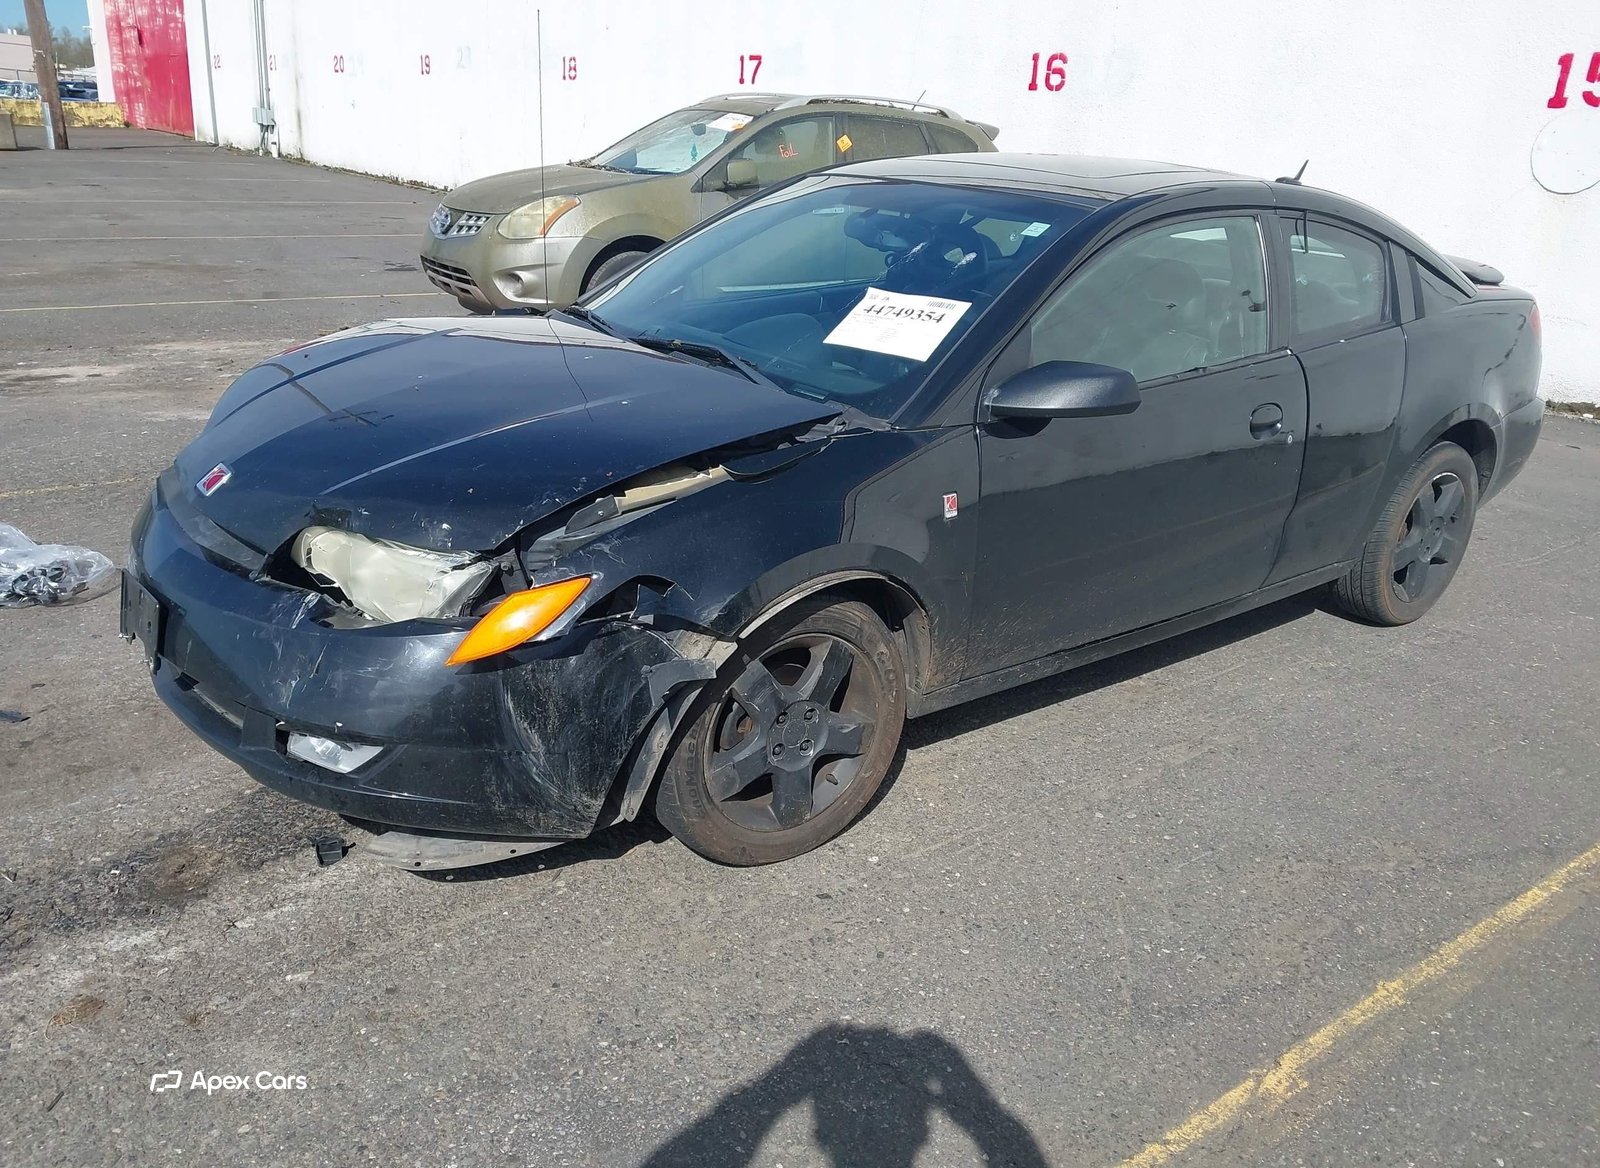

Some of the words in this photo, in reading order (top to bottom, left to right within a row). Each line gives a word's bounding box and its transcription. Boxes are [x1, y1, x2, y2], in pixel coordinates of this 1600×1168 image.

[213, 54, 221, 69] 22
[269, 54, 277, 71] 21
[333, 55, 345, 73] 20
[420, 55, 431, 75] 19
[562, 56, 577, 80] 18
[739, 54, 762, 85] 17
[1028, 52, 1068, 92] 16
[863, 304, 946, 323] 44749354
